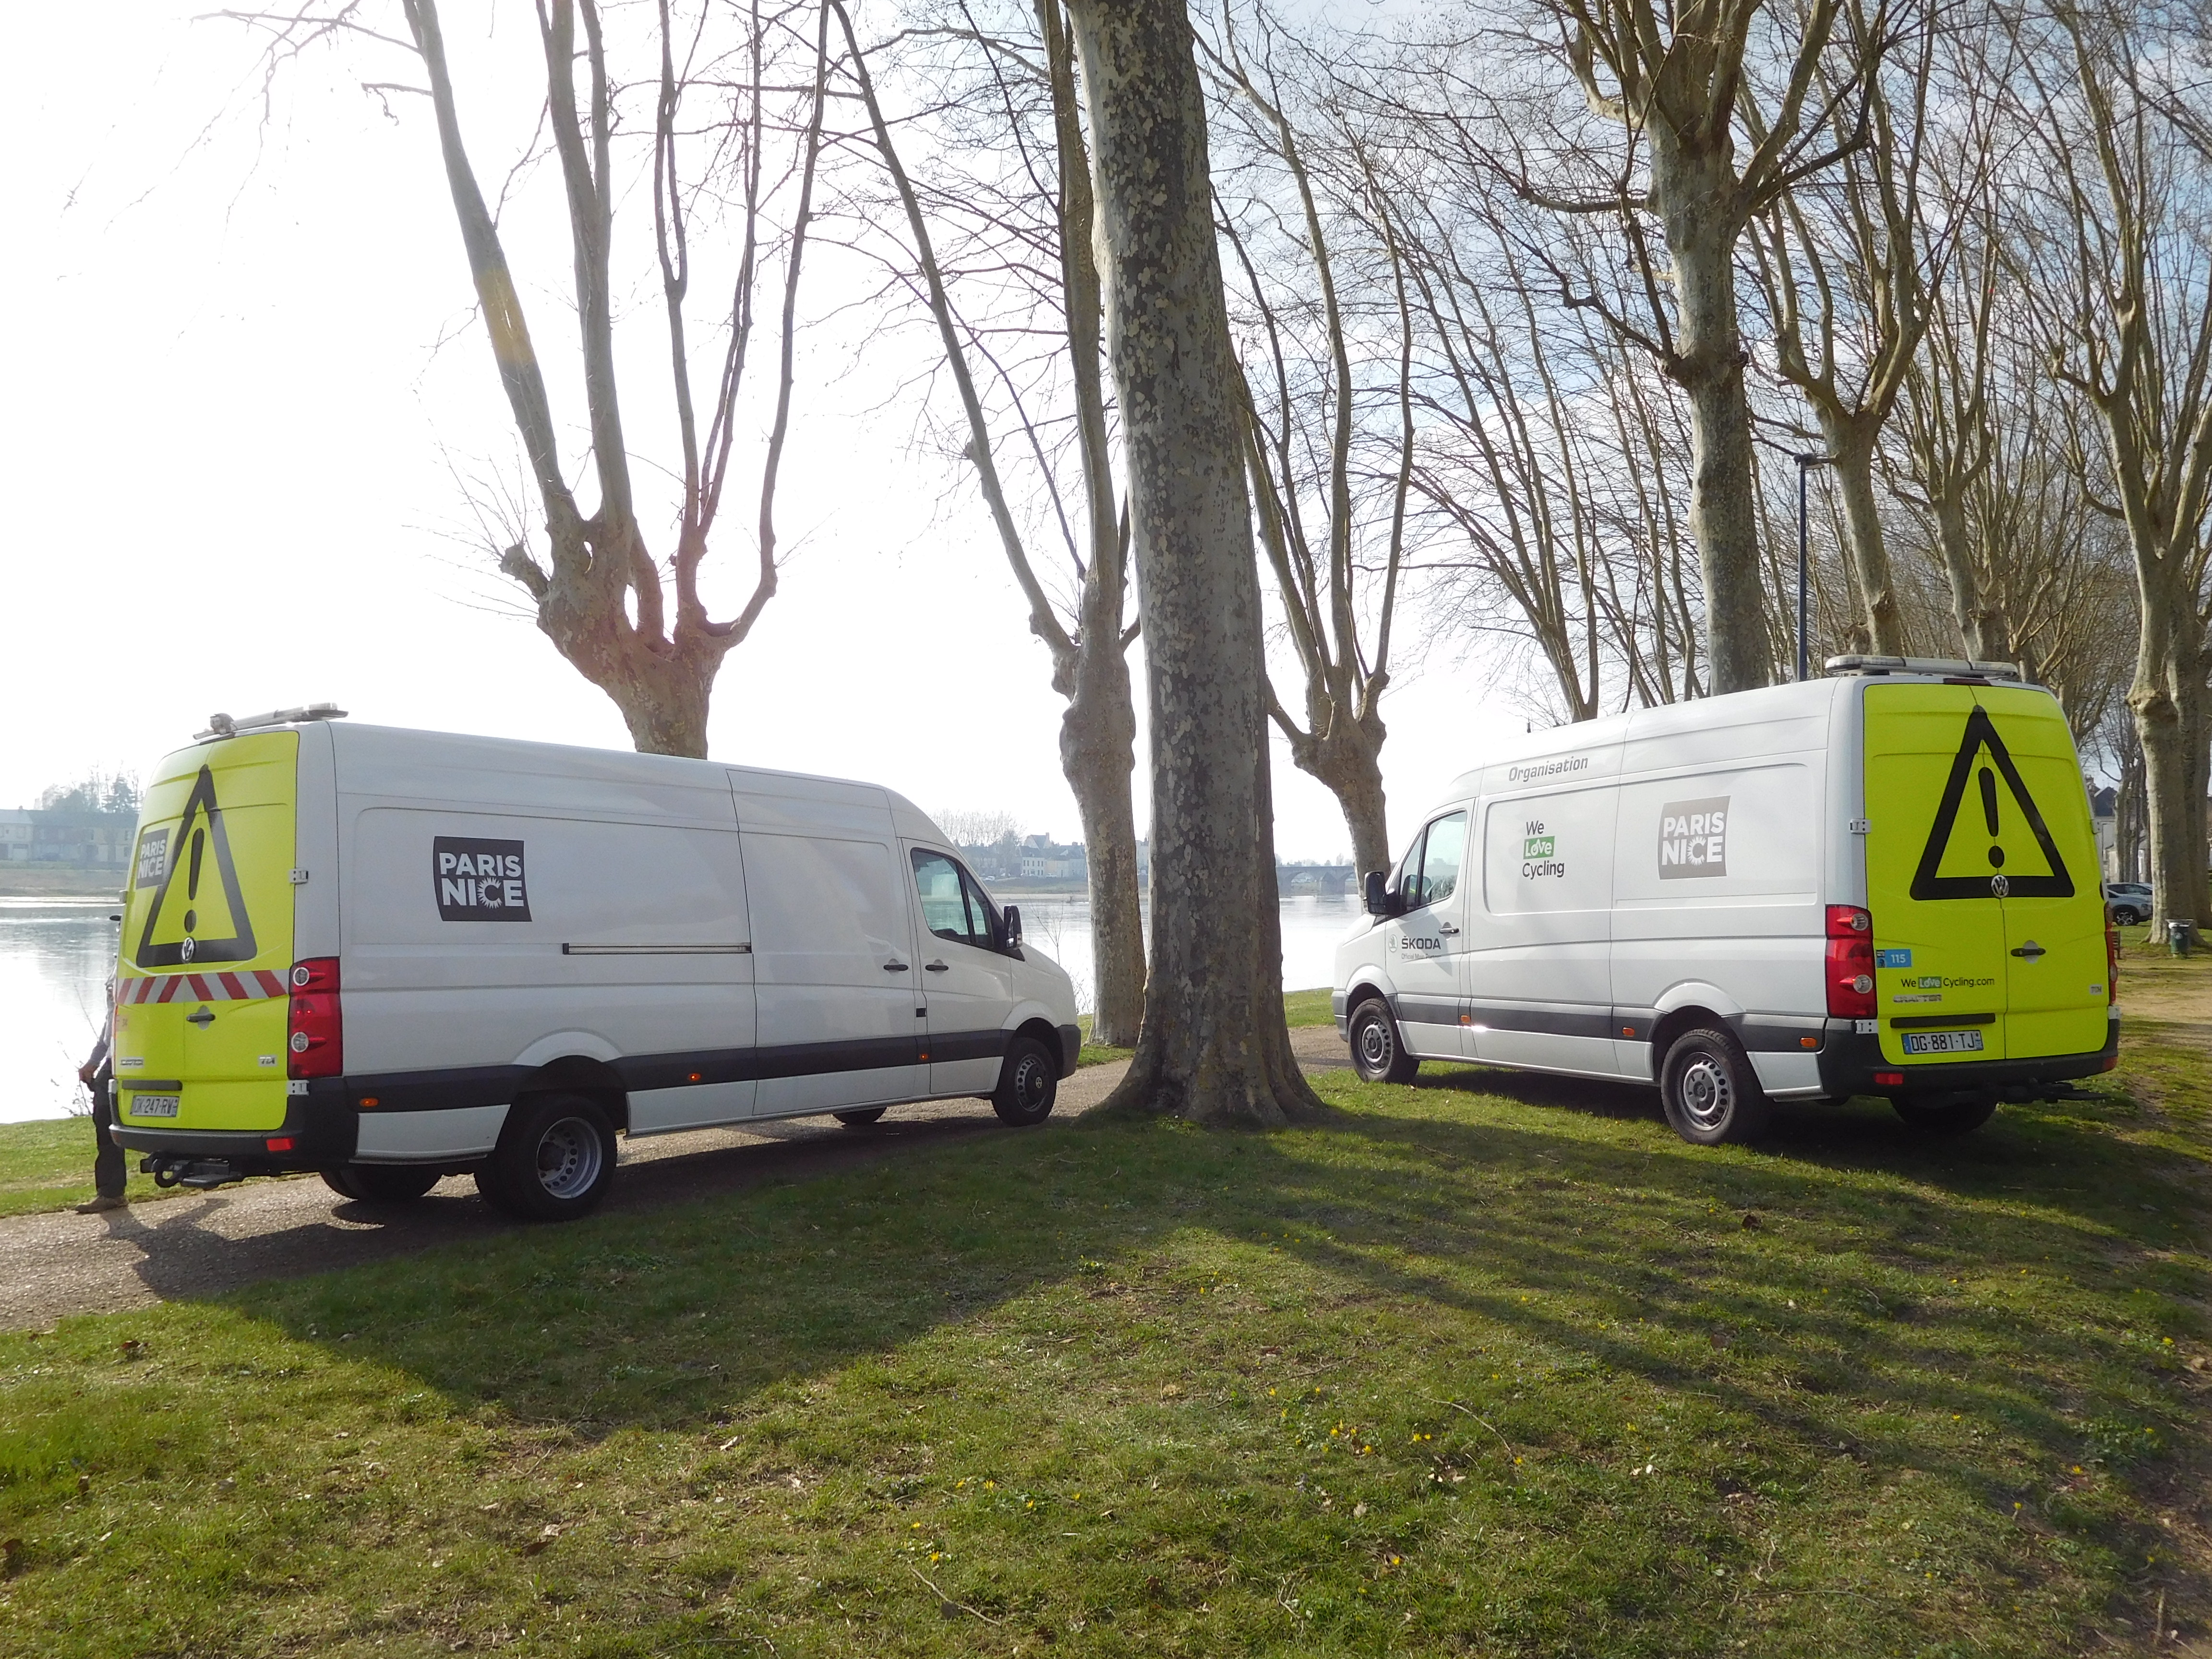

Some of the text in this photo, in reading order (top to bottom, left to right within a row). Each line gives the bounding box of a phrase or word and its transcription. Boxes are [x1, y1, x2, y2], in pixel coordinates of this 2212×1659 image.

[1509, 756, 1588, 782] Organisation
[1526, 820, 1544, 835] We
[1663, 812, 1724, 838] PARIS
[140, 839, 166, 859] PARIS
[1661, 835, 1723, 866] NICE
[138, 856, 164, 879] NICE
[439, 853, 522, 878] PARIS
[1522, 860, 1565, 880] Cycling
[441, 877, 525, 910] NICE
[1401, 936, 1441, 950] ŠKODA
[1890, 954, 1906, 963] 115
[1901, 979, 1916, 987] We
[1943, 977, 1995, 988] Cycling.com
[1911, 1033, 1975, 1051] DG-881-TJ
